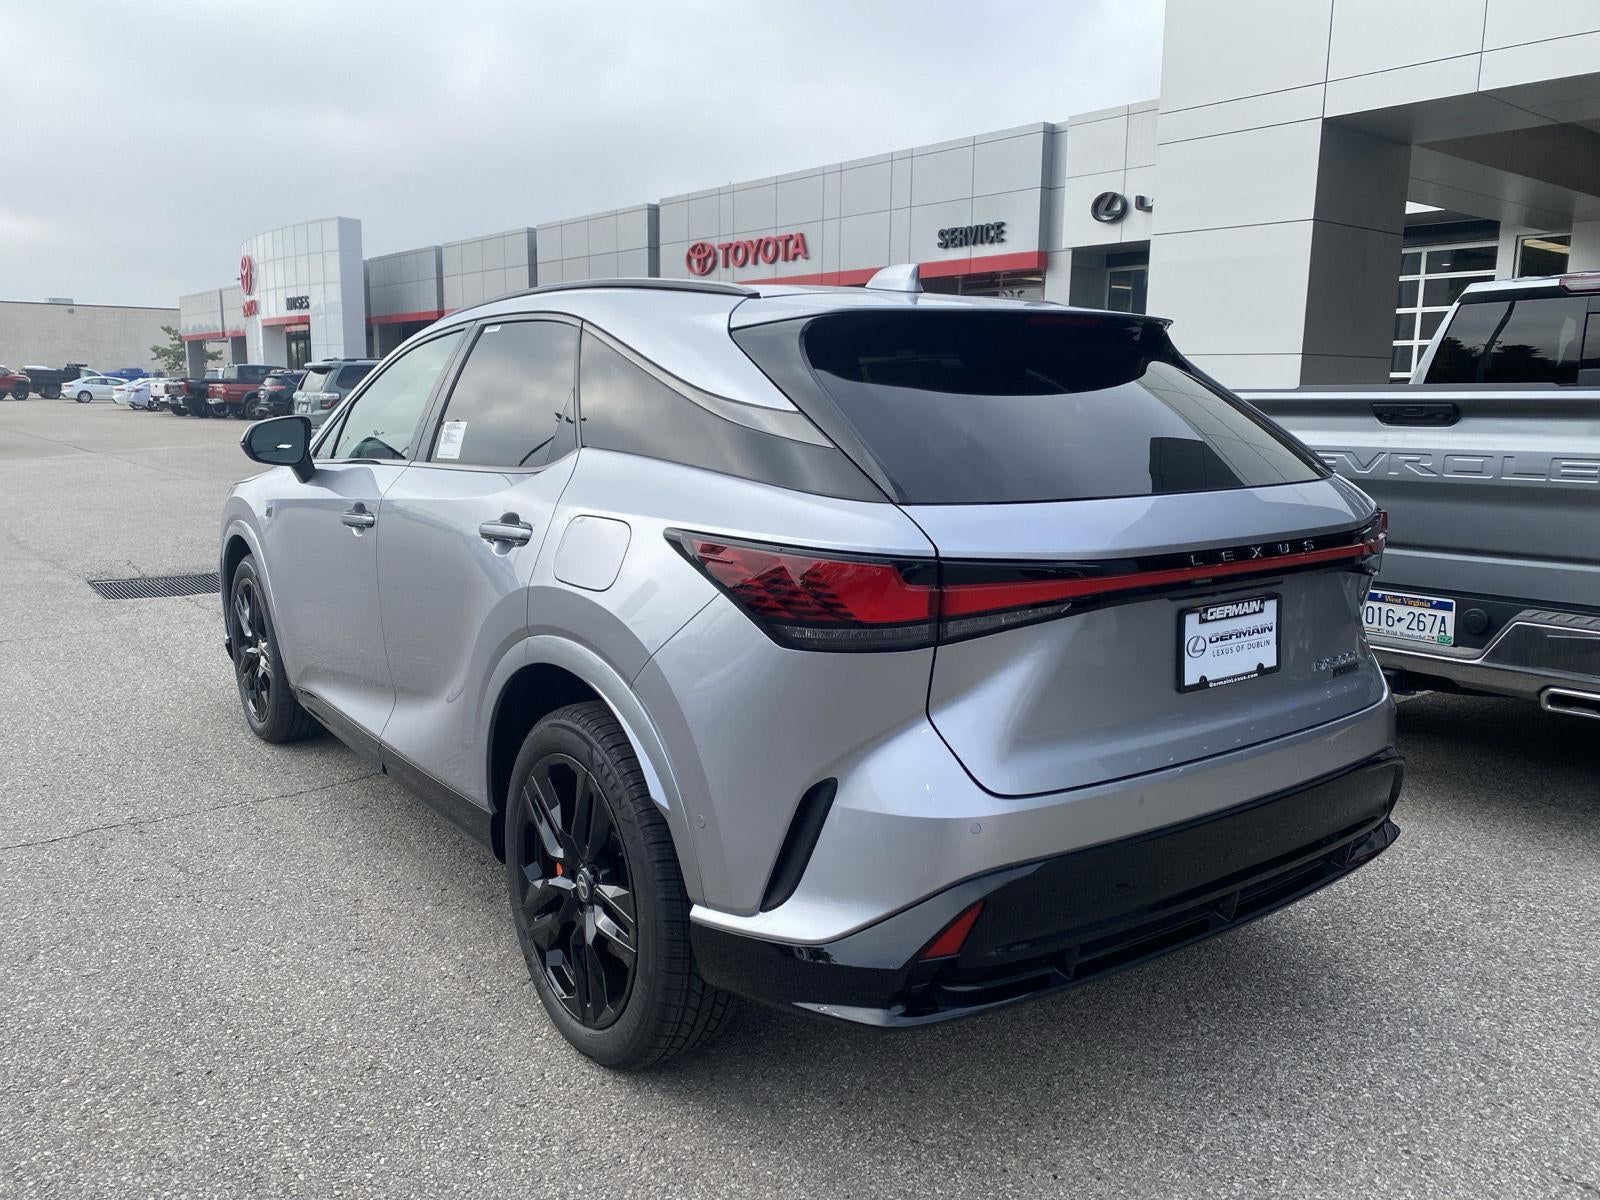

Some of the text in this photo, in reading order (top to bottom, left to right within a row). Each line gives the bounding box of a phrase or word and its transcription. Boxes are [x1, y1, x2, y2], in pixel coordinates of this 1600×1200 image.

[936, 221, 1006, 250] SERVICE
[717, 232, 809, 269] TOYOTA
[1190, 539, 1314, 567] LEXUS
[1207, 599, 1261, 620] GERMAIN
[1384, 594, 1431, 608] West Virginia
[1208, 622, 1274, 644] GERMAIN
[1212, 640, 1271, 658] LEXUS OF DUBLIN
[1208, 672, 1259, 688] GermainLexus.com
